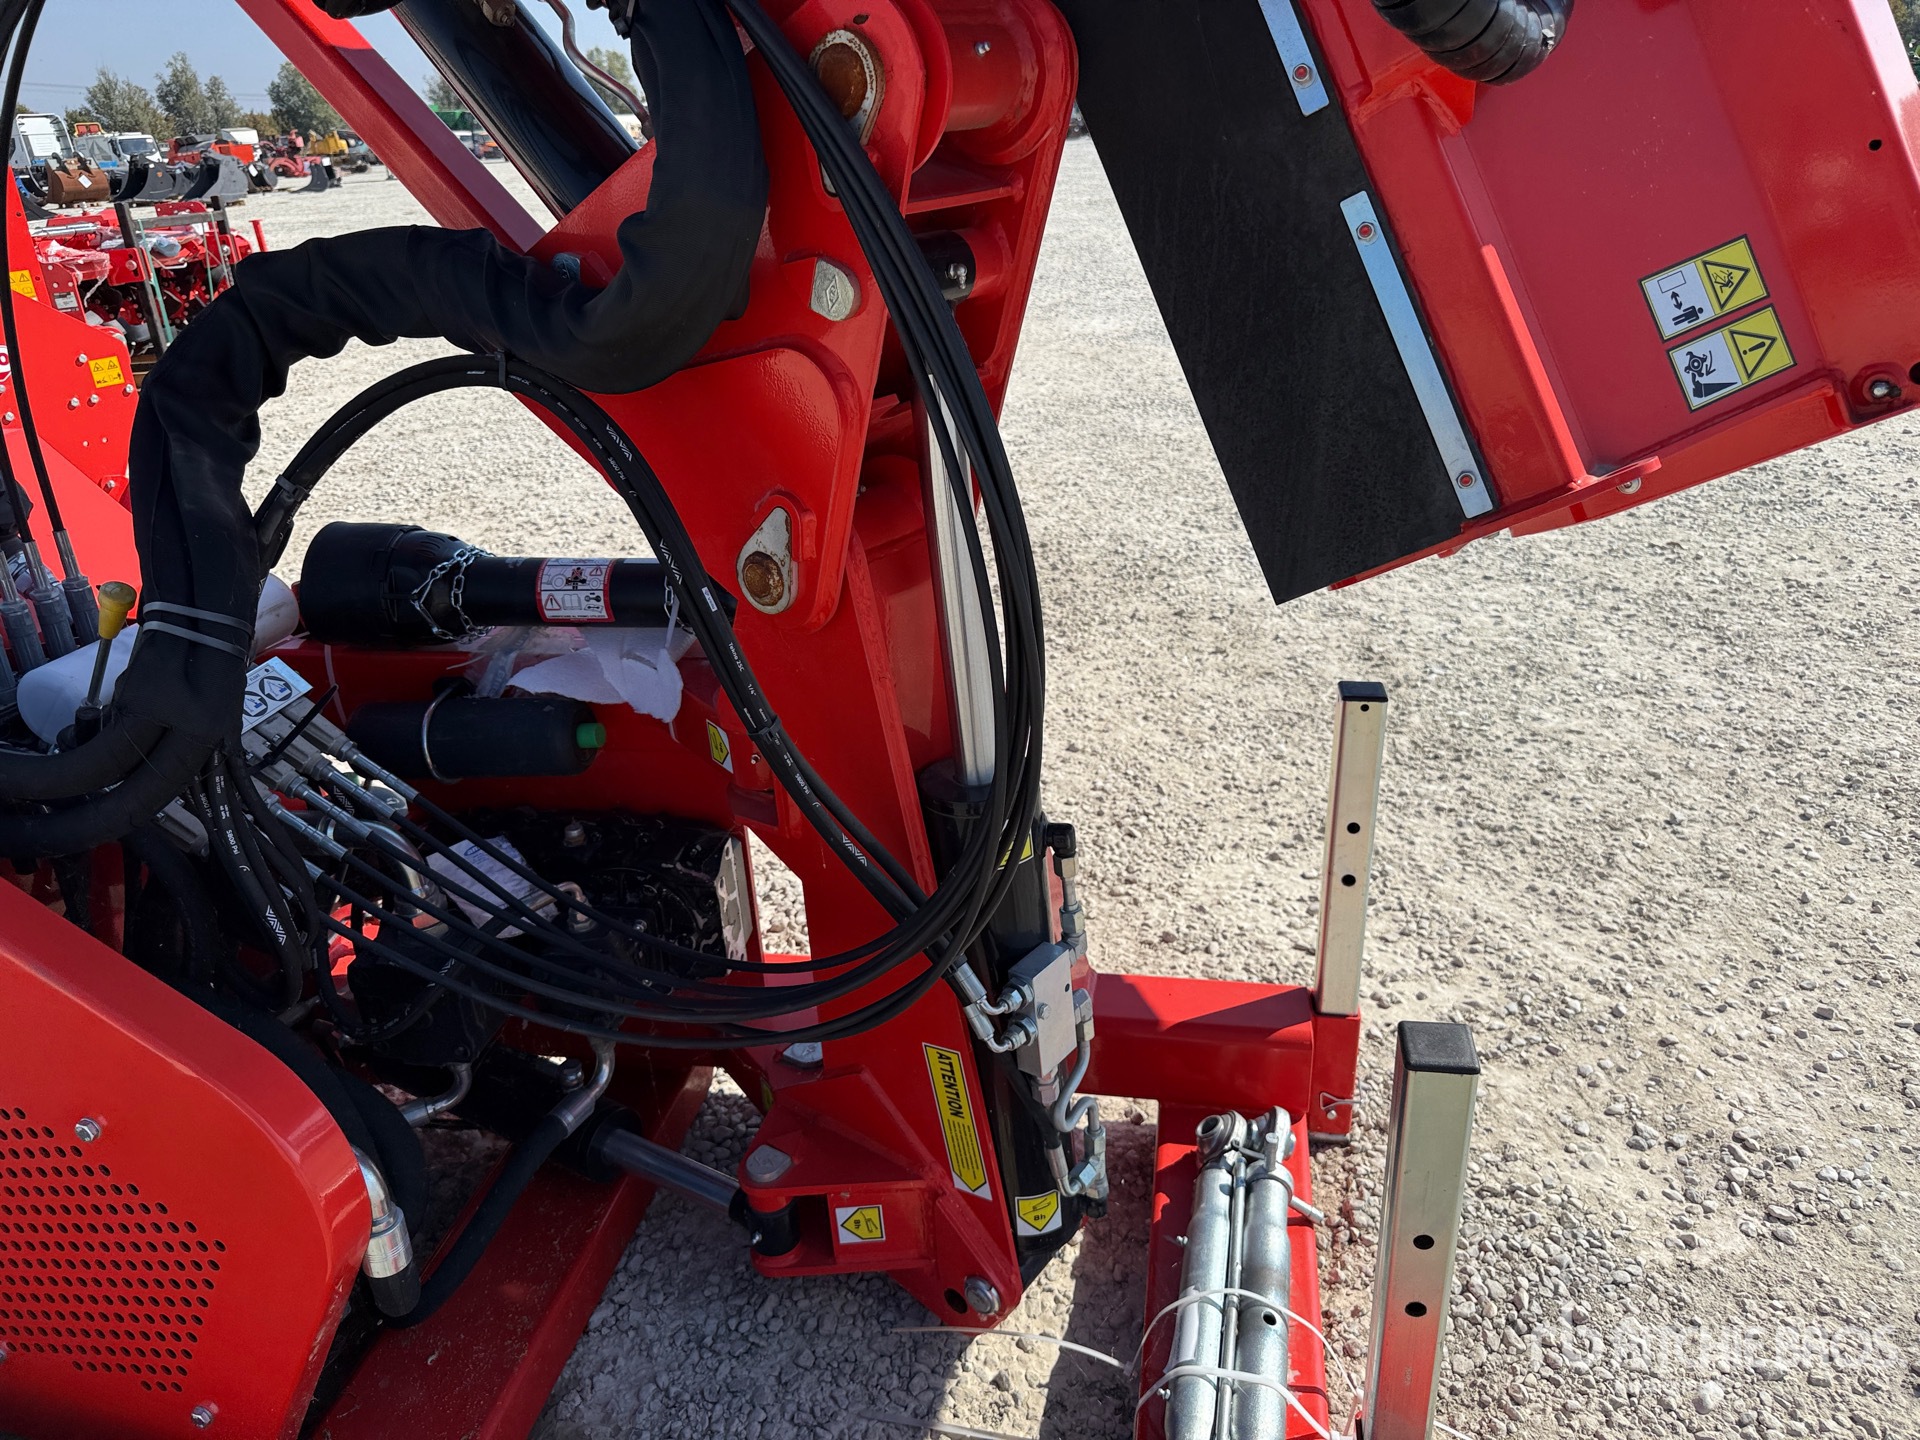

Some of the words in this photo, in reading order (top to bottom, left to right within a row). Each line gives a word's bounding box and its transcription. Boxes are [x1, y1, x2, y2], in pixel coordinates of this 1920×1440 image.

[728, 641, 739, 661] Tekno
[225, 829, 237, 846] 5800
[231, 844, 241, 855] Psi
[936, 1051, 964, 1119] ATTENTION
